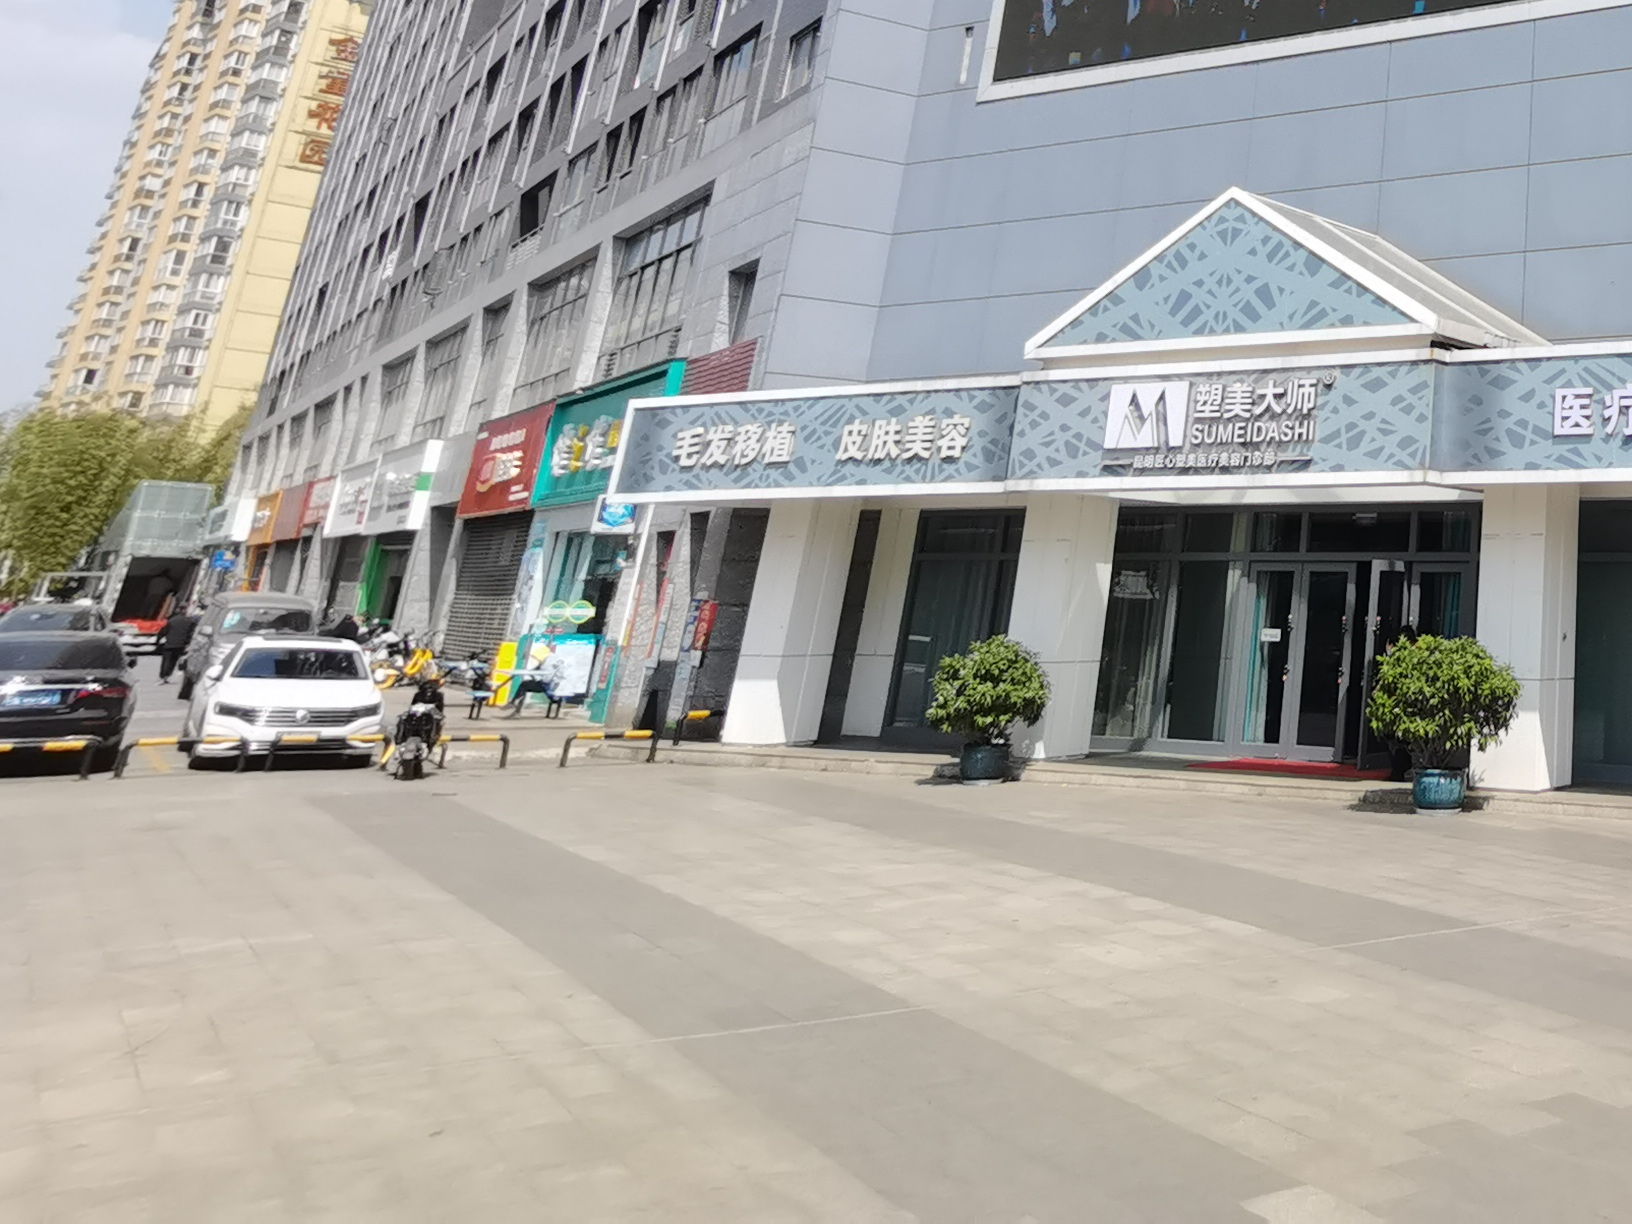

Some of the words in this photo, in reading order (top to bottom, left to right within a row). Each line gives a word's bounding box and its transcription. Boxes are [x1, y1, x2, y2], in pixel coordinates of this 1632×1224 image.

[1192, 378, 1318, 420] 塑美大师
[671, 423, 797, 469] 毛发移植
[835, 414, 972, 463] 皮肤美容
[1190, 421, 1316, 446] SUMEIDASHI
